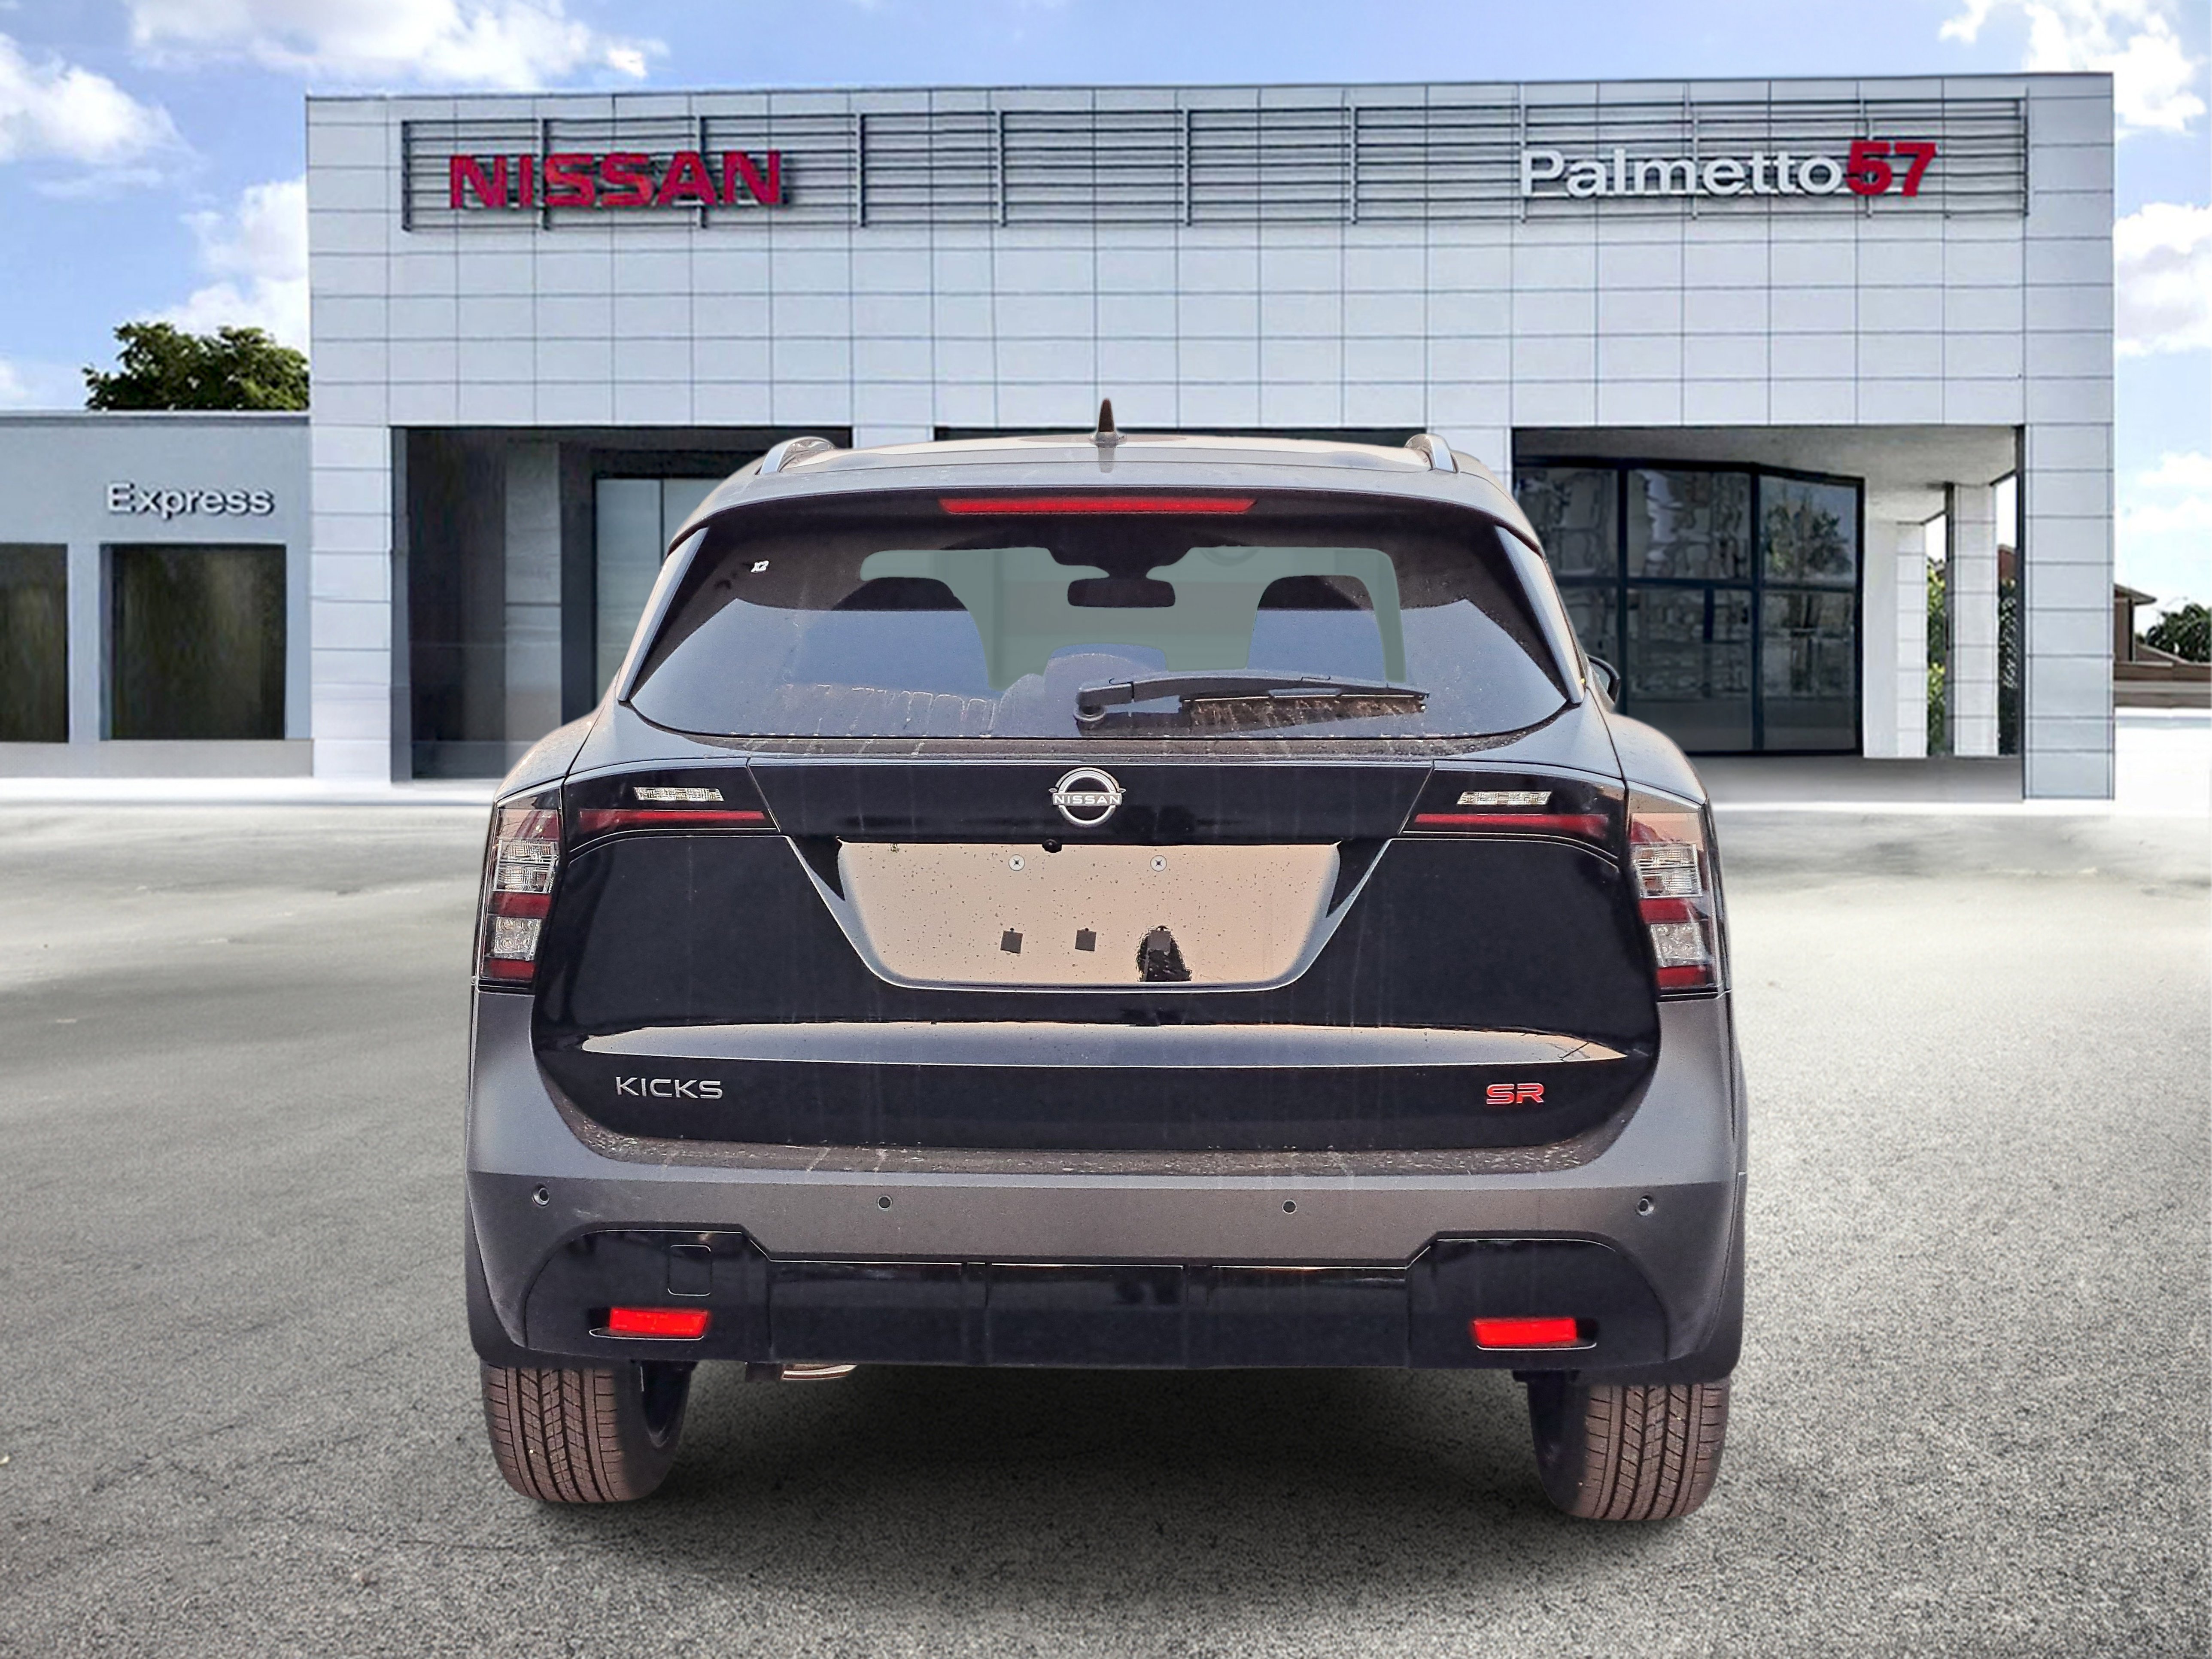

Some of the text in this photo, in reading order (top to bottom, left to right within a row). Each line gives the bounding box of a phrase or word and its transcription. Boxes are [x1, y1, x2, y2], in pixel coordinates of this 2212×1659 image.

[450, 150, 781, 209] NISSAN
[107, 483, 274, 519] Express
[1054, 795, 1120, 805] NISSAN
[616, 1077, 723, 1099] KICKS
[1486, 1083, 1544, 1104] SR
